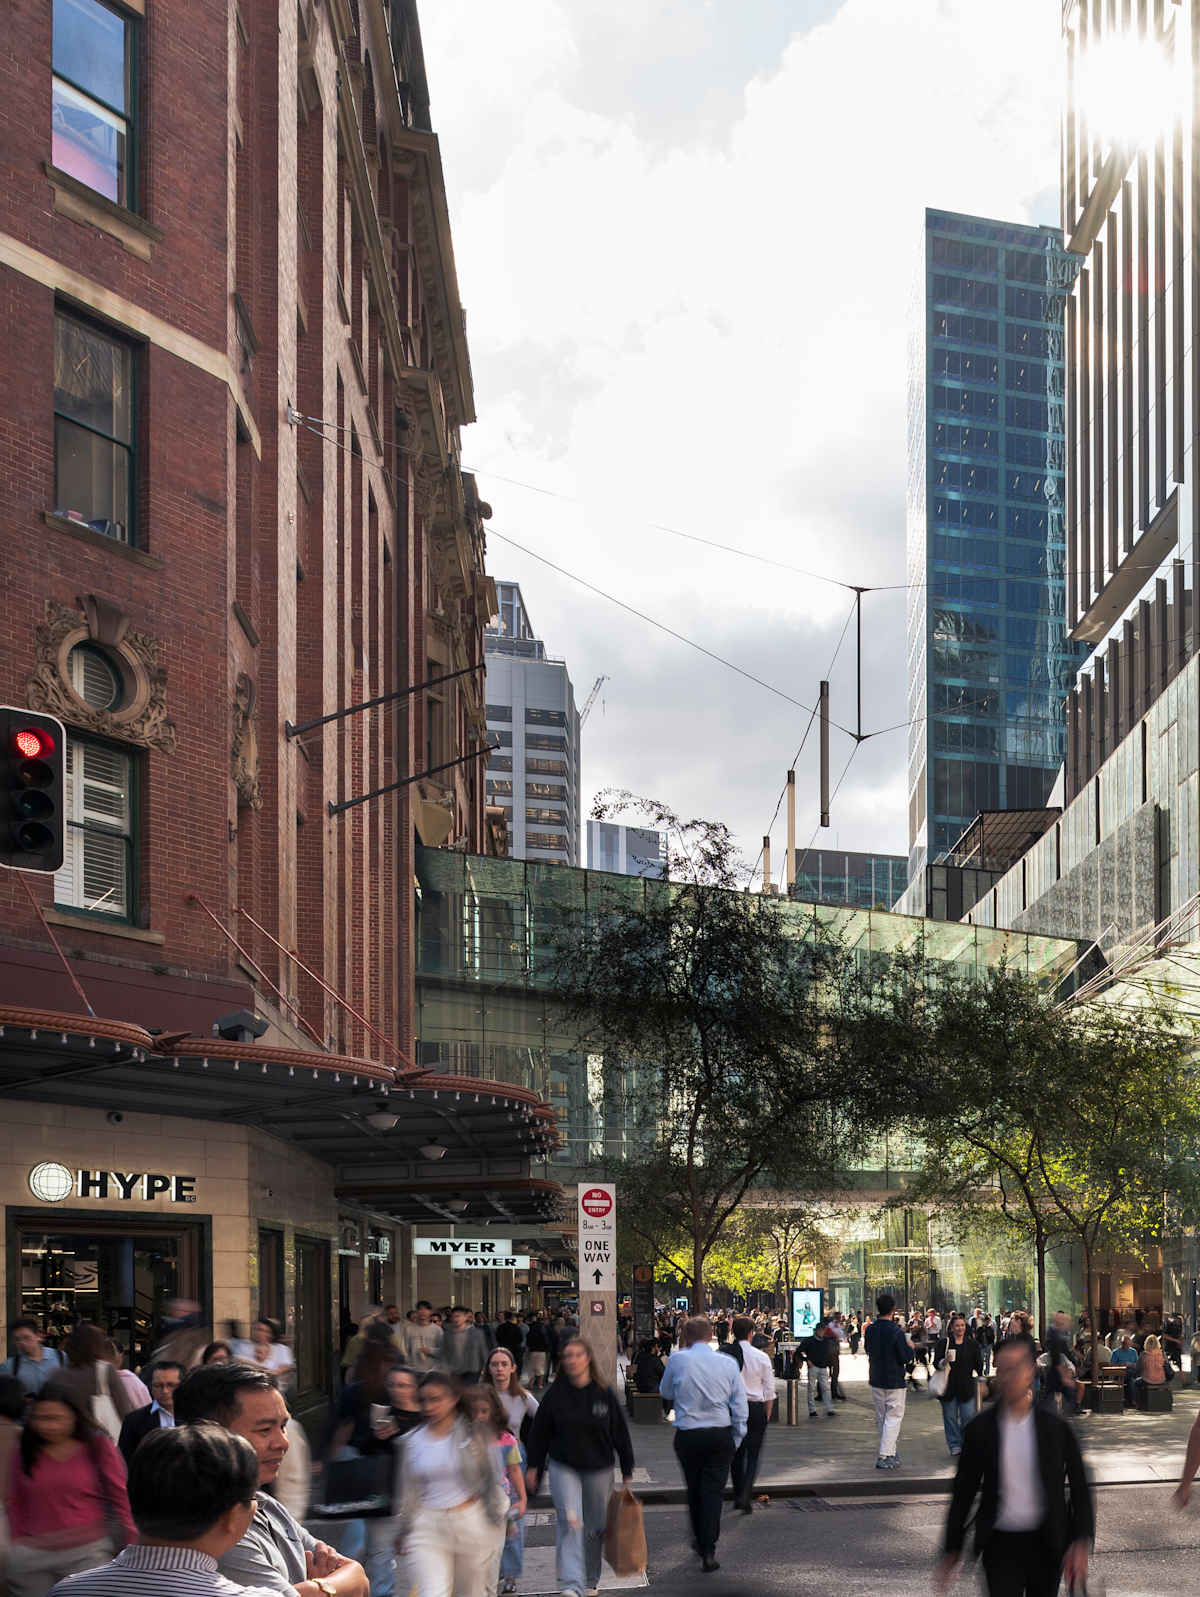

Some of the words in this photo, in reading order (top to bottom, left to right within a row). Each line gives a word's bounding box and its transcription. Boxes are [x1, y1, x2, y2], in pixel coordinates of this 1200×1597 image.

[77, 1169, 197, 1202] HYPE
[430, 1241, 496, 1253] MYER
[585, 1240, 609, 1251] ONE
[464, 1258, 517, 1267] MYER
[584, 1252, 611, 1263] WAY
